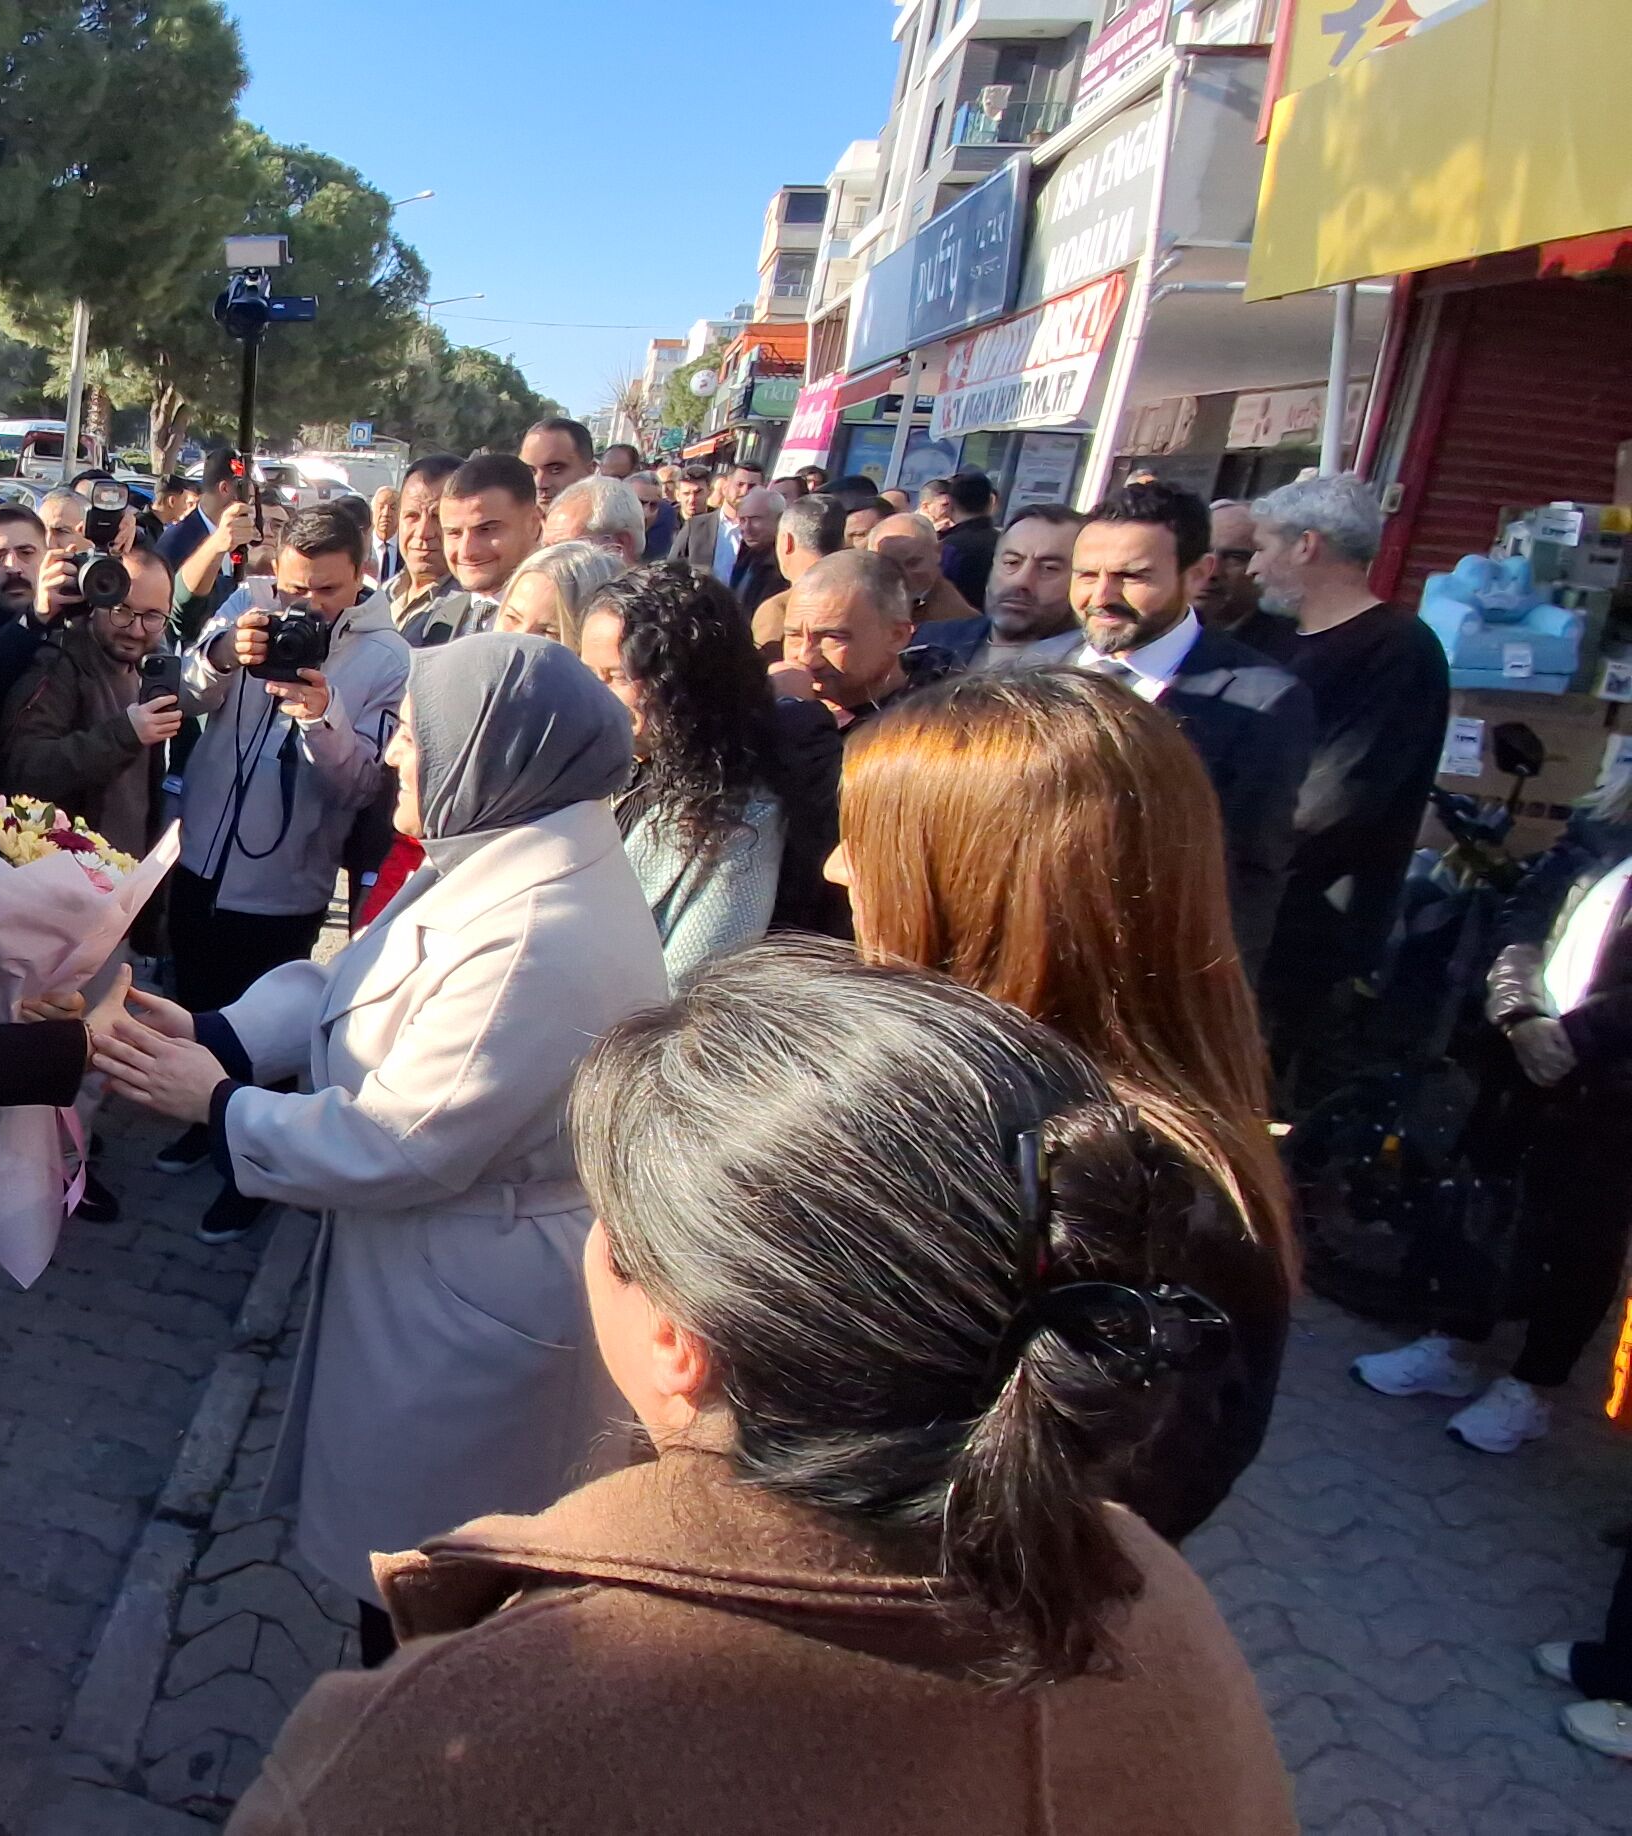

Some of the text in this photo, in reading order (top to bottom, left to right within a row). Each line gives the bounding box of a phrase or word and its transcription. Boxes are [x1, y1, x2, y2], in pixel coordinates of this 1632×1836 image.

[913, 222, 961, 325] puffy
[1042, 207, 1134, 295] MOBİLYA
[356, 428, 366, 440] D
